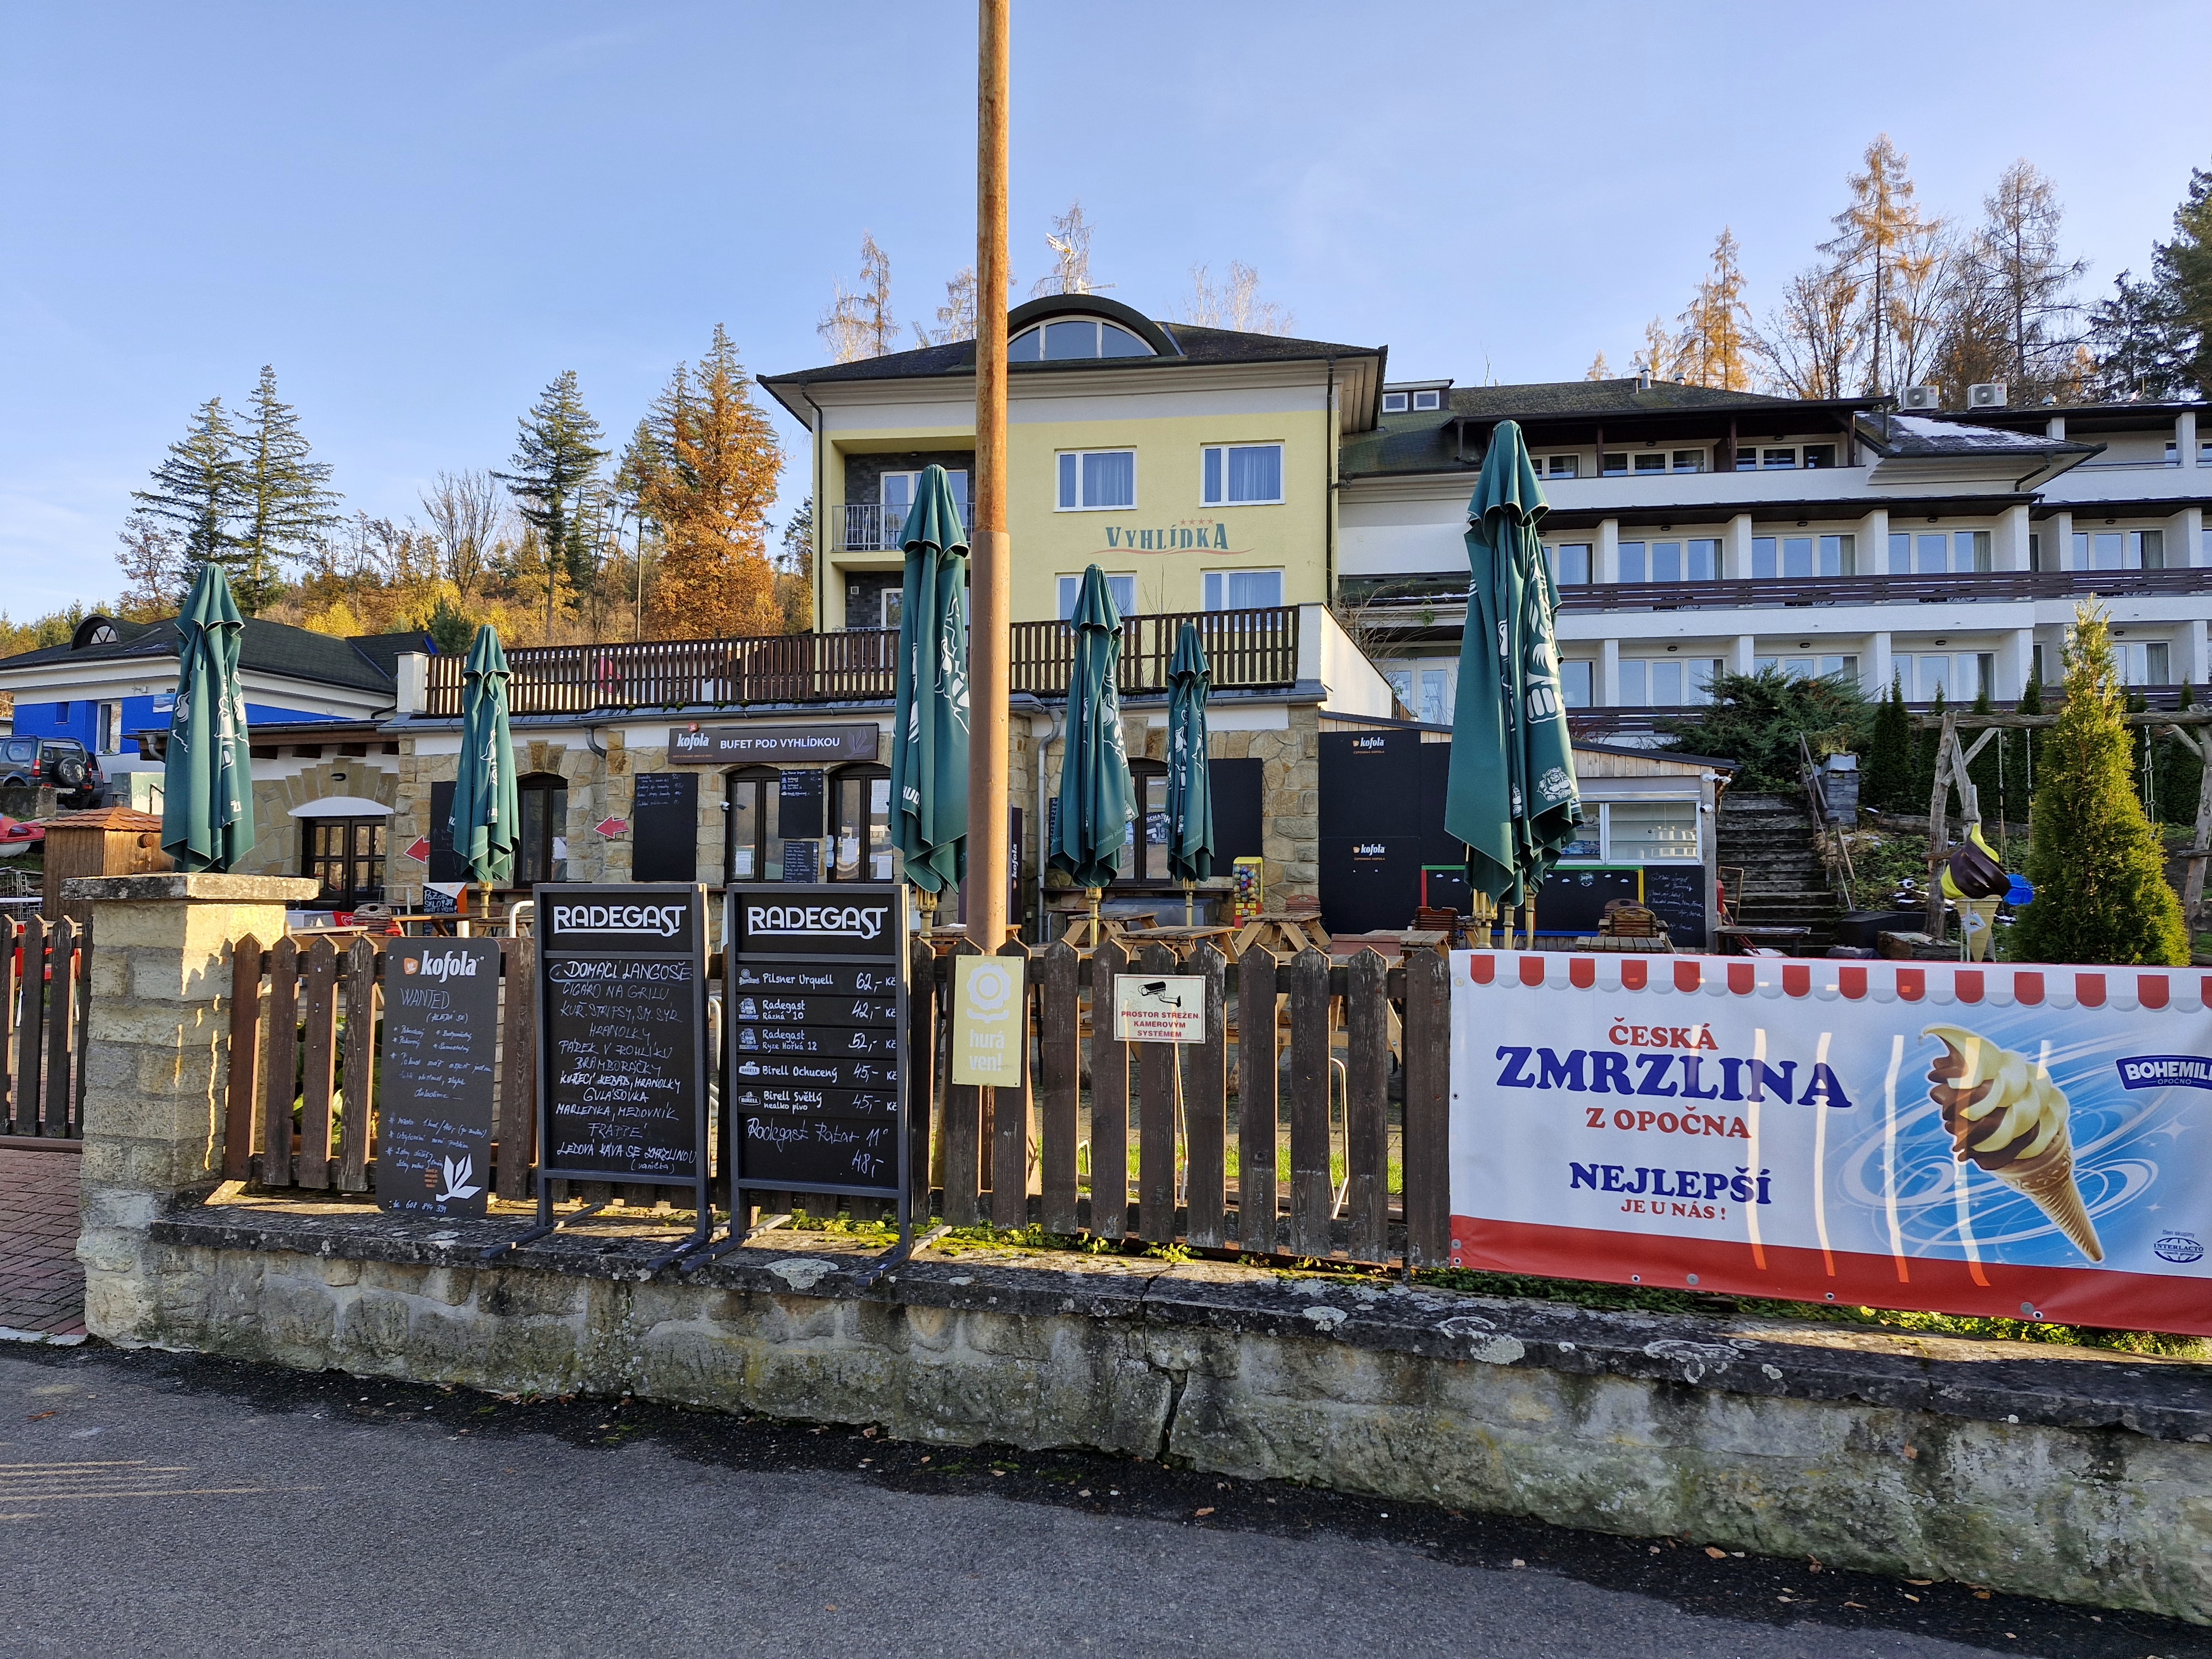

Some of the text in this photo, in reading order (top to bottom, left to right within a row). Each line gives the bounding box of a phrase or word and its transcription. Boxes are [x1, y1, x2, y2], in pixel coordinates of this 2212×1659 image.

[1105, 523, 1229, 550] VYHLÍDKA
[676, 733, 709, 751] kofola
[721, 735, 840, 749] BUFET POD VYHLÍDKOU
[1360, 737, 1384, 749] kofola
[1361, 844, 1385, 855] kofola
[554, 905, 687, 937] RADEGAST
[748, 906, 888, 940] RADEGAST
[420, 950, 477, 983] kofola
[763, 973, 795, 983] Pilsner
[799, 974, 833, 989] Urquell
[886, 977, 896, 985] Kč
[399, 988, 450, 1009] WANTED
[606, 985, 623, 997] NA
[628, 985, 669, 1000] GRILU
[763, 999, 806, 1013] Radegast
[886, 1008, 896, 1018] Kč
[763, 1011, 785, 1020] Rázná
[589, 1022, 650, 1046] HRANOLKY
[763, 1029, 805, 1042] Radegast
[885, 1040, 896, 1049] Kč
[970, 1029, 1004, 1048] hurá
[1608, 1016, 1719, 1050] ČESKÁ
[604, 1042, 612, 1055] V
[615, 1041, 672, 1058] ROHLÍKU
[763, 1042, 779, 1052] Ryze
[782, 1041, 804, 1050] Hořká
[807, 1042, 817, 1050] 12
[969, 1052, 1002, 1071] ven!
[762, 1065, 789, 1076] Birell
[793, 1066, 837, 1083] Ochucený
[886, 1071, 897, 1080] Kč
[1495, 1045, 1853, 1108] ZMRZLINA
[764, 1091, 790, 1101] Birell
[794, 1091, 822, 1108] Světlý
[886, 1101, 897, 1111] Kč
[792, 1102, 808, 1114] pivo
[617, 1102, 679, 1120] MEDOVNÍK
[1585, 1106, 1752, 1139] Z OPOČNA
[747, 1117, 808, 1152] Radegast
[557, 1139, 697, 1164] LEDOVÁ KÁVA SE ZMRZLINOU
[1569, 1162, 1772, 1204] NEJLEPŠÍ
[406, 1200, 417, 1208] 608
[1621, 1199, 1646, 1213] JE
[1651, 1202, 1666, 1214] U
[1671, 1201, 1715, 1219] NÁS
[2153, 1243, 2204, 1251] INTERLACTO
